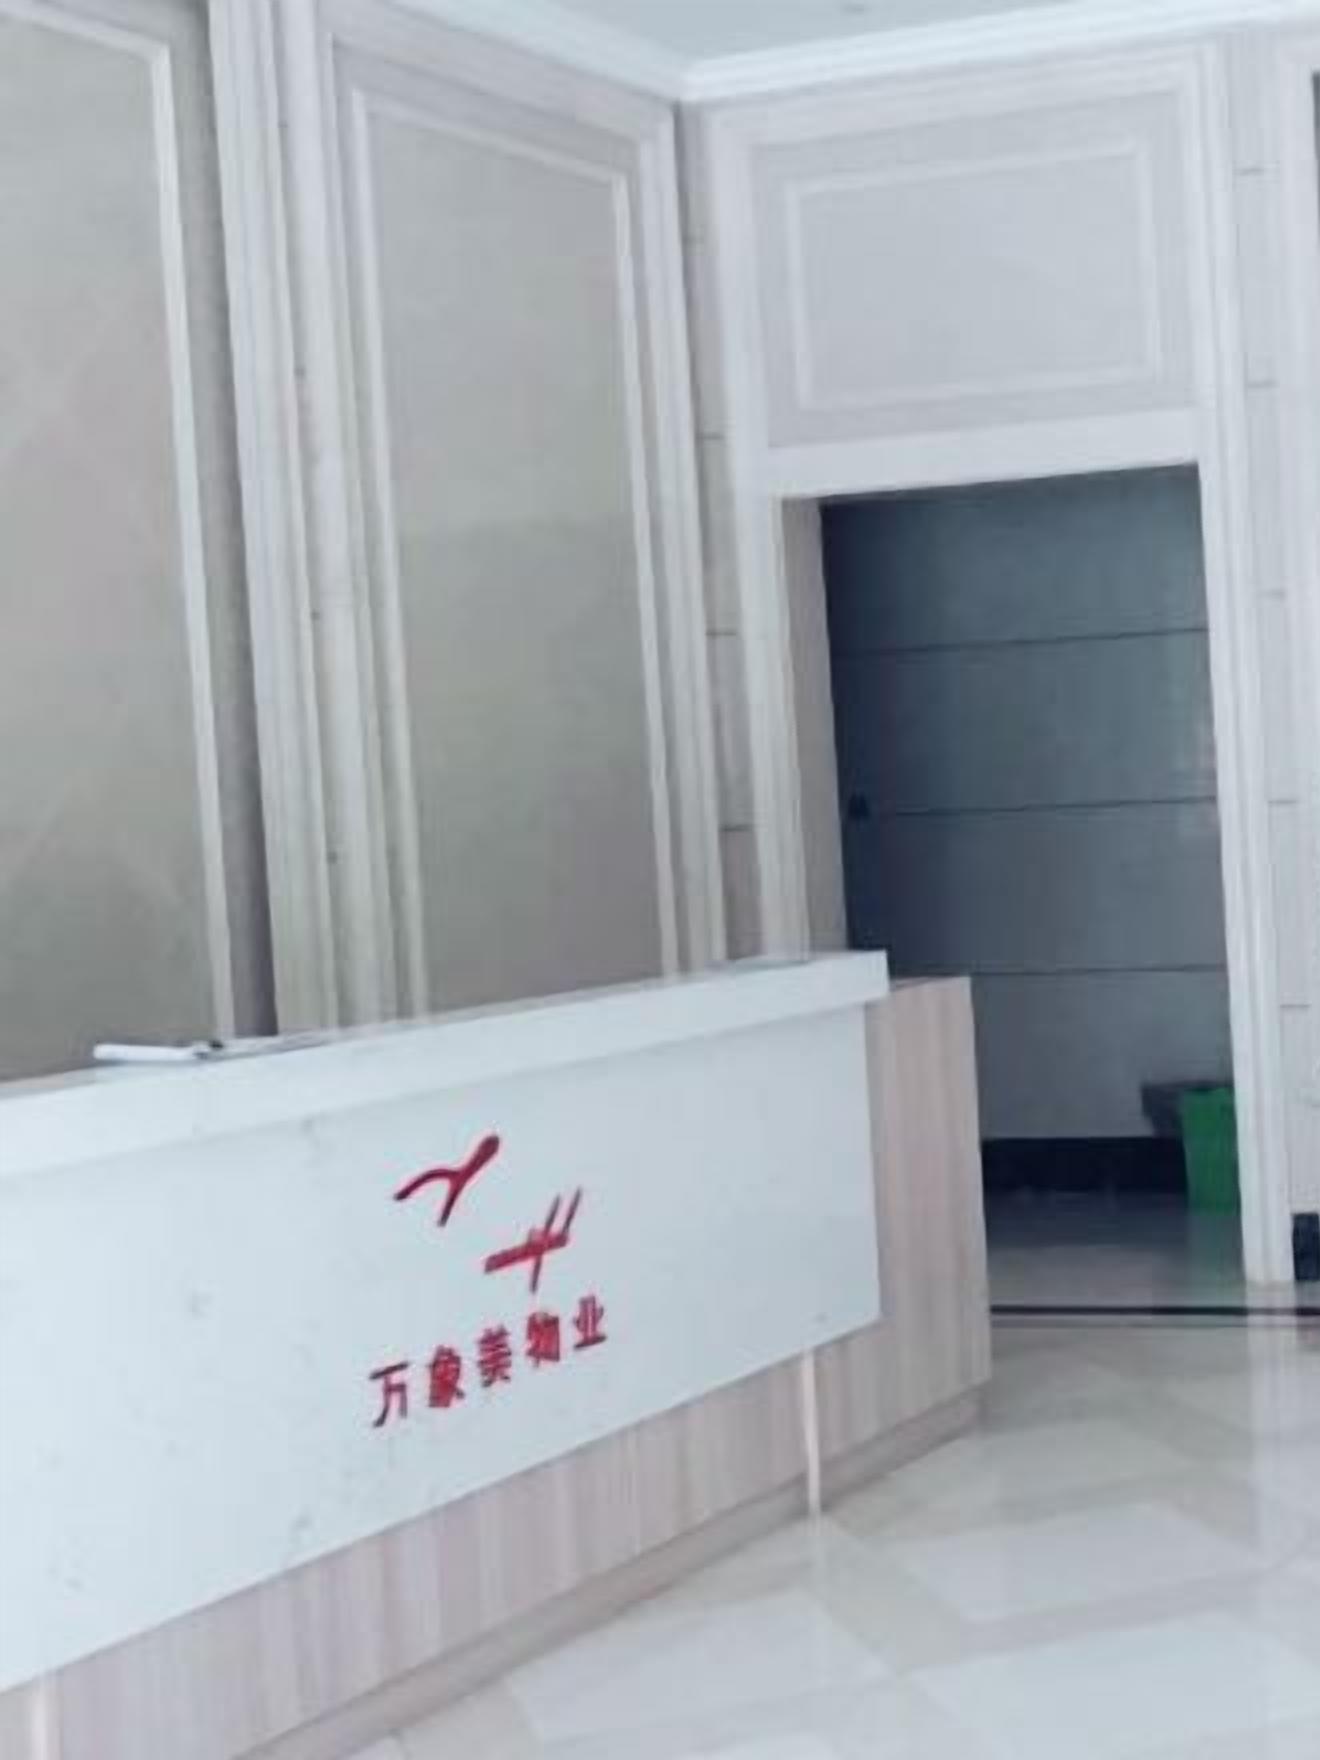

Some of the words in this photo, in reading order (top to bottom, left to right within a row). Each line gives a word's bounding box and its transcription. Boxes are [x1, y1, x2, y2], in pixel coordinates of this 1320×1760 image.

[369, 1295, 607, 1427] 万象美物业
